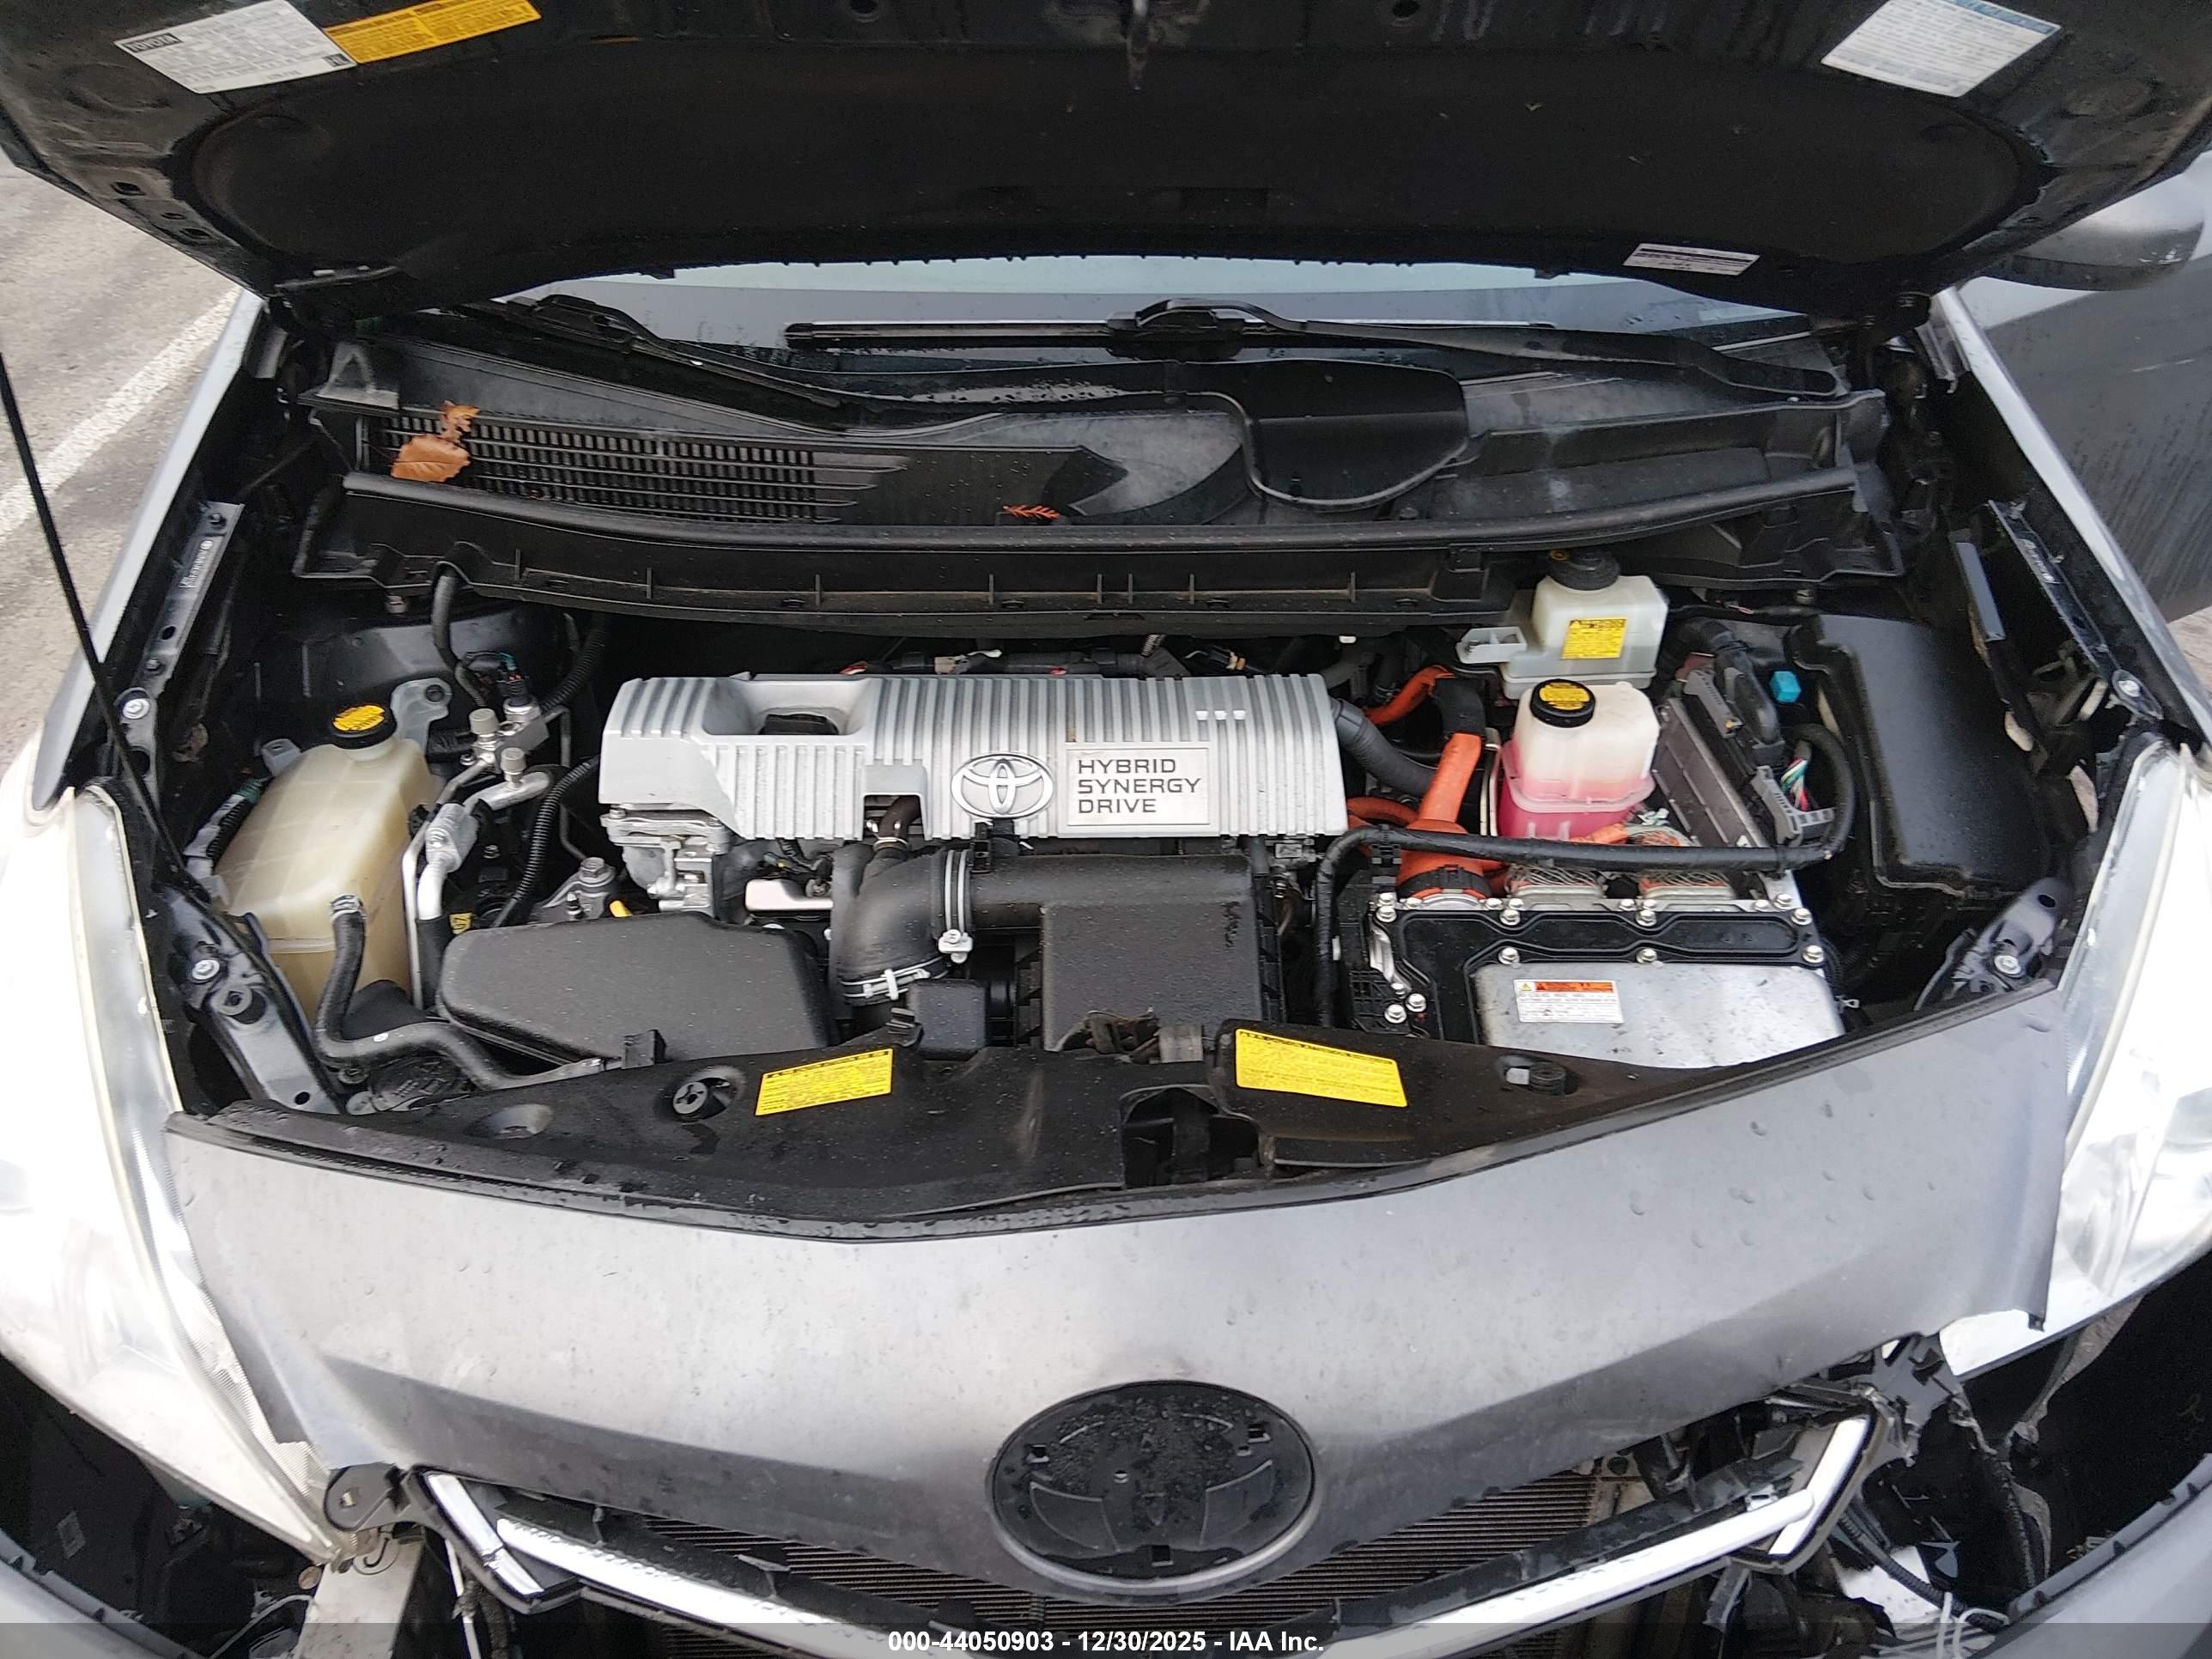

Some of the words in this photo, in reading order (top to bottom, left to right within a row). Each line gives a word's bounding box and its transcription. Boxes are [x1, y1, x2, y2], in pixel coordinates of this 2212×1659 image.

[123, 34, 179, 52] TOYOTA
[1078, 758, 1176, 774] HYBRID
[1078, 777, 1201, 793] SYNERGY
[1078, 798, 1157, 813] DRIVE
